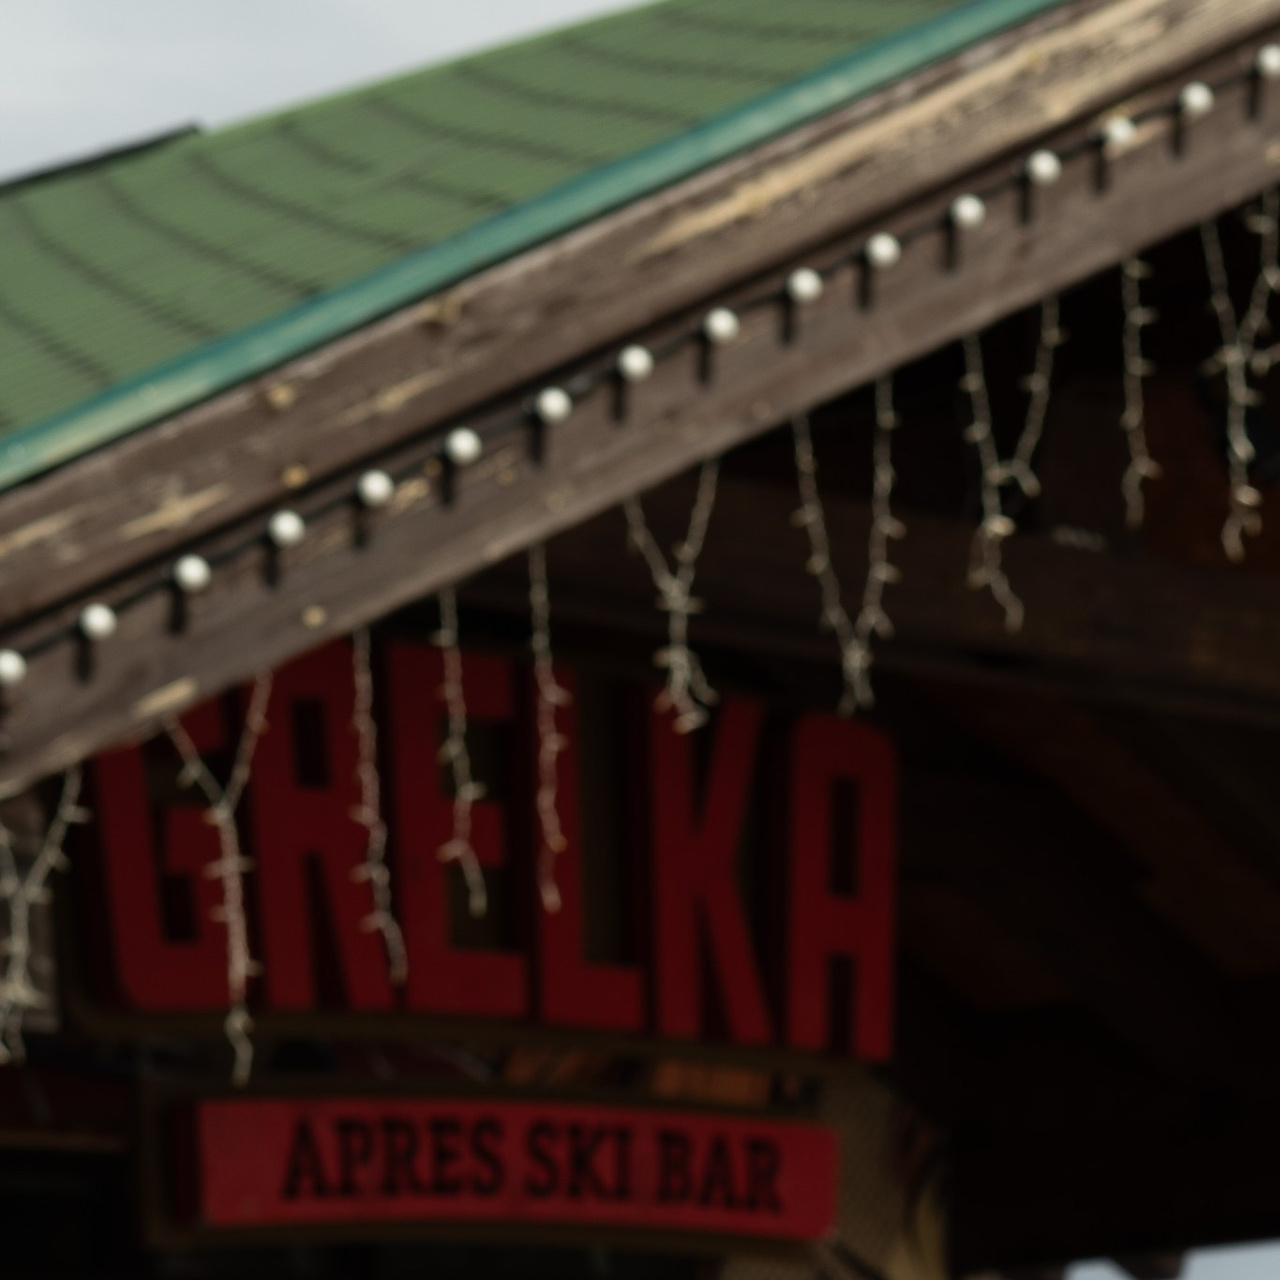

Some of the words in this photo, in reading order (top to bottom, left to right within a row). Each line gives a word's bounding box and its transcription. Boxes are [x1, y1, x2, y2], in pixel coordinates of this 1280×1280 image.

[92, 636, 897, 1060] GRELKA
[283, 1116, 505, 1199] APRES
[523, 1120, 632, 1200] SKI
[655, 1127, 785, 1214] BAR
